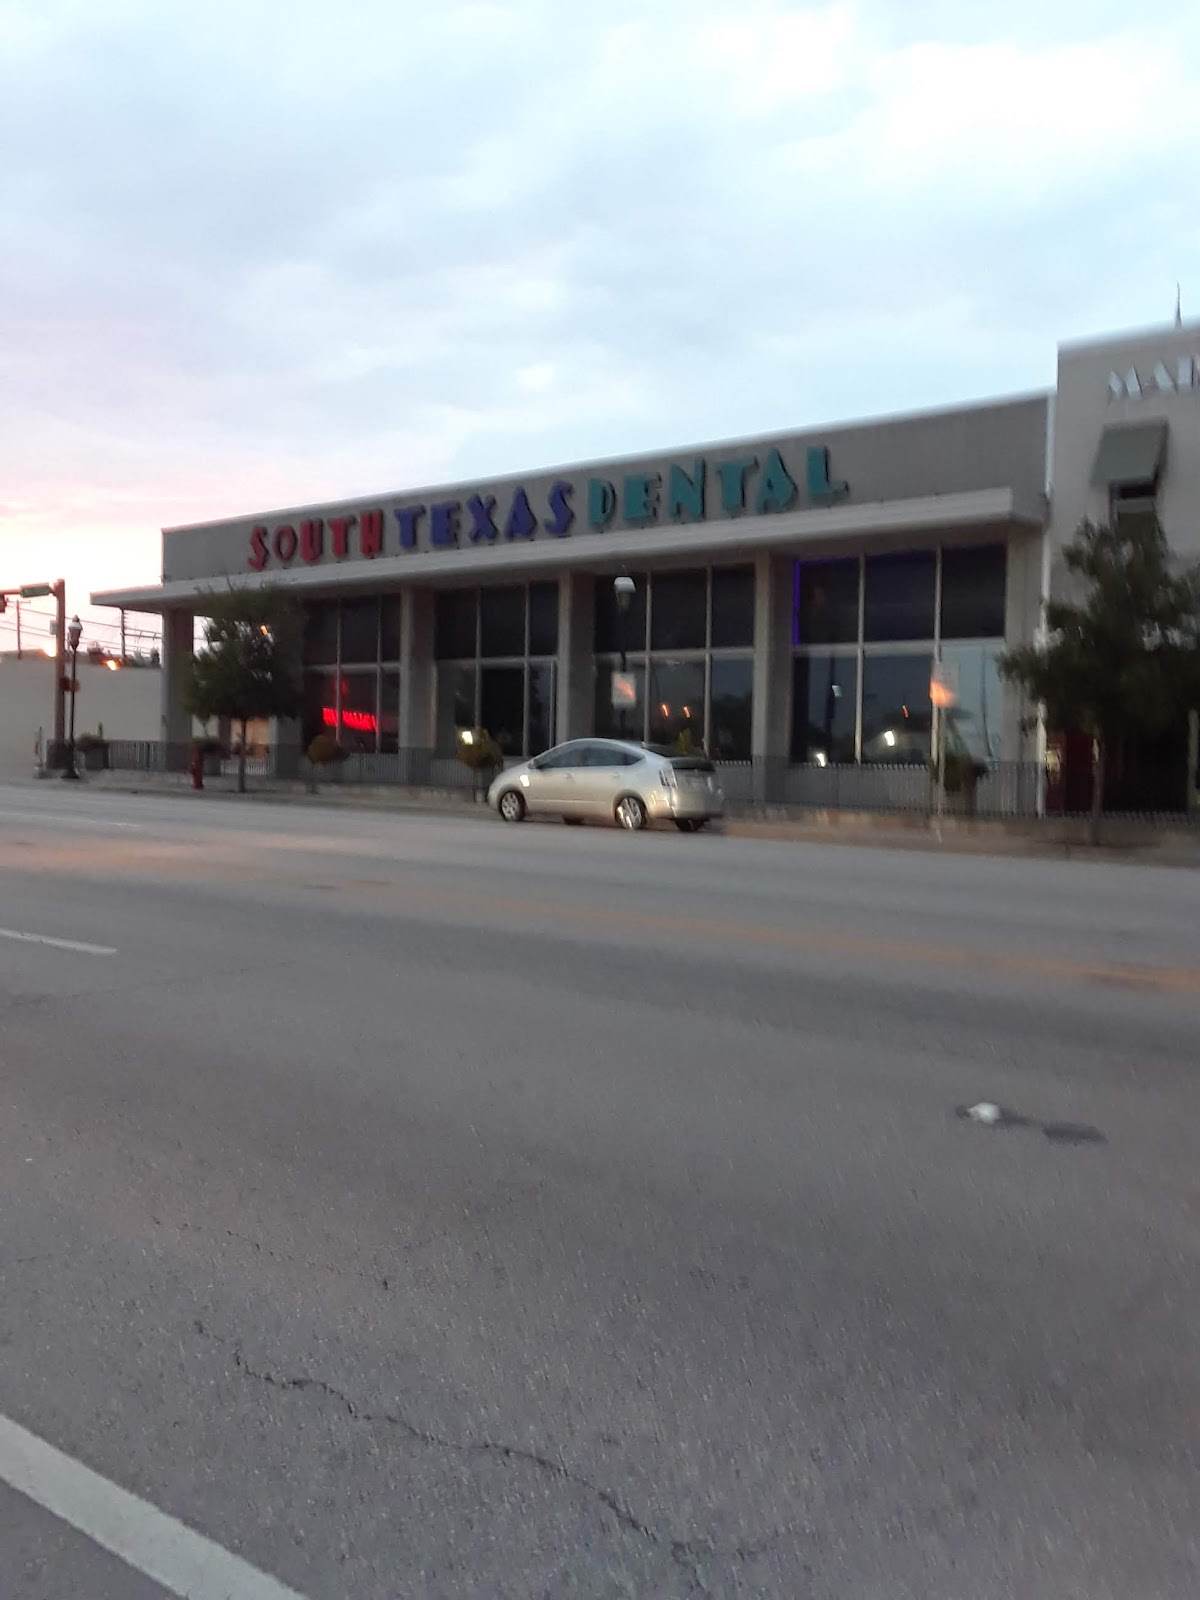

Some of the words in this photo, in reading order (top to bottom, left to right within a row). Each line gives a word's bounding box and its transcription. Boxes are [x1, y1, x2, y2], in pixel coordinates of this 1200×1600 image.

[249, 507, 383, 572] SOUTH
[394, 480, 575, 549] TEXAS
[588, 445, 849, 530] DENTAL
